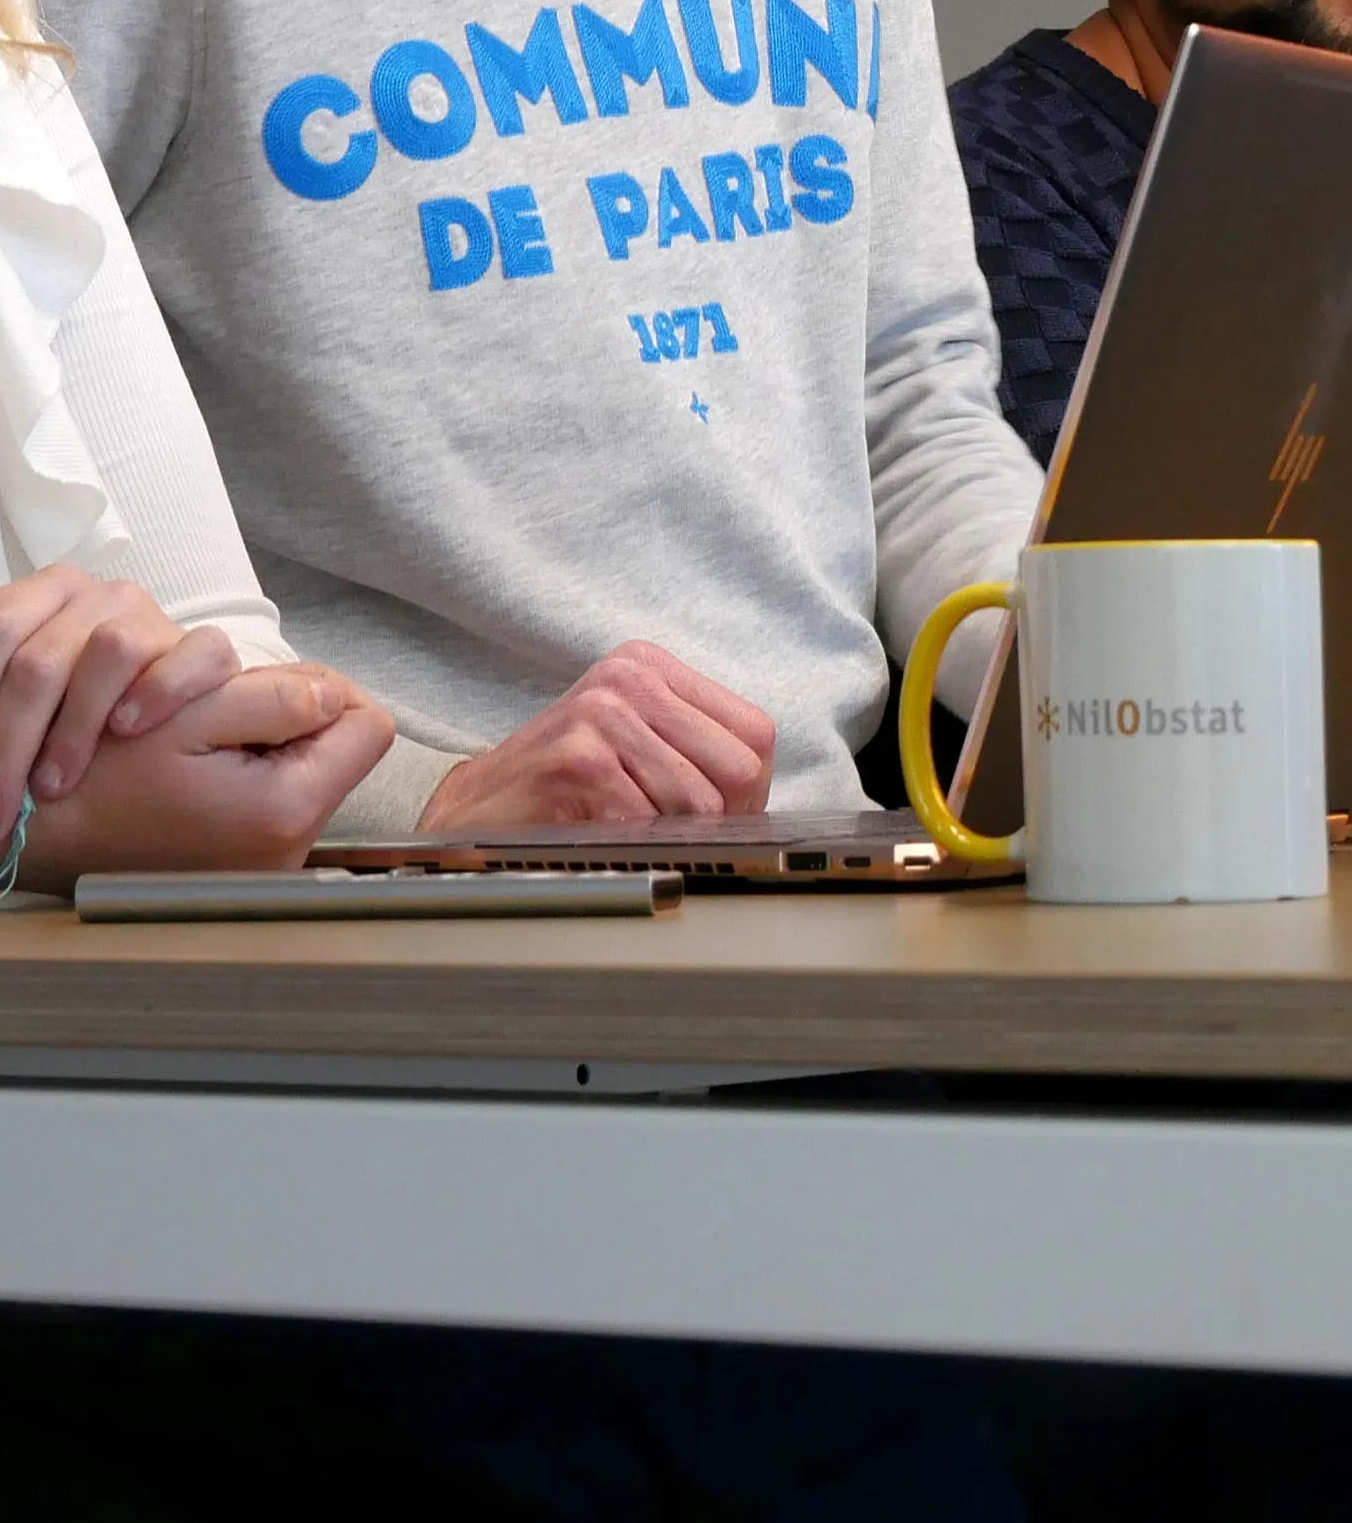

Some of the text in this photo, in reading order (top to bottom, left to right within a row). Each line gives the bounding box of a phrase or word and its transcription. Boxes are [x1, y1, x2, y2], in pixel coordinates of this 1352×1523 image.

[419, 134, 855, 292] DE PARIS
[627, 302, 738, 363] 1871
